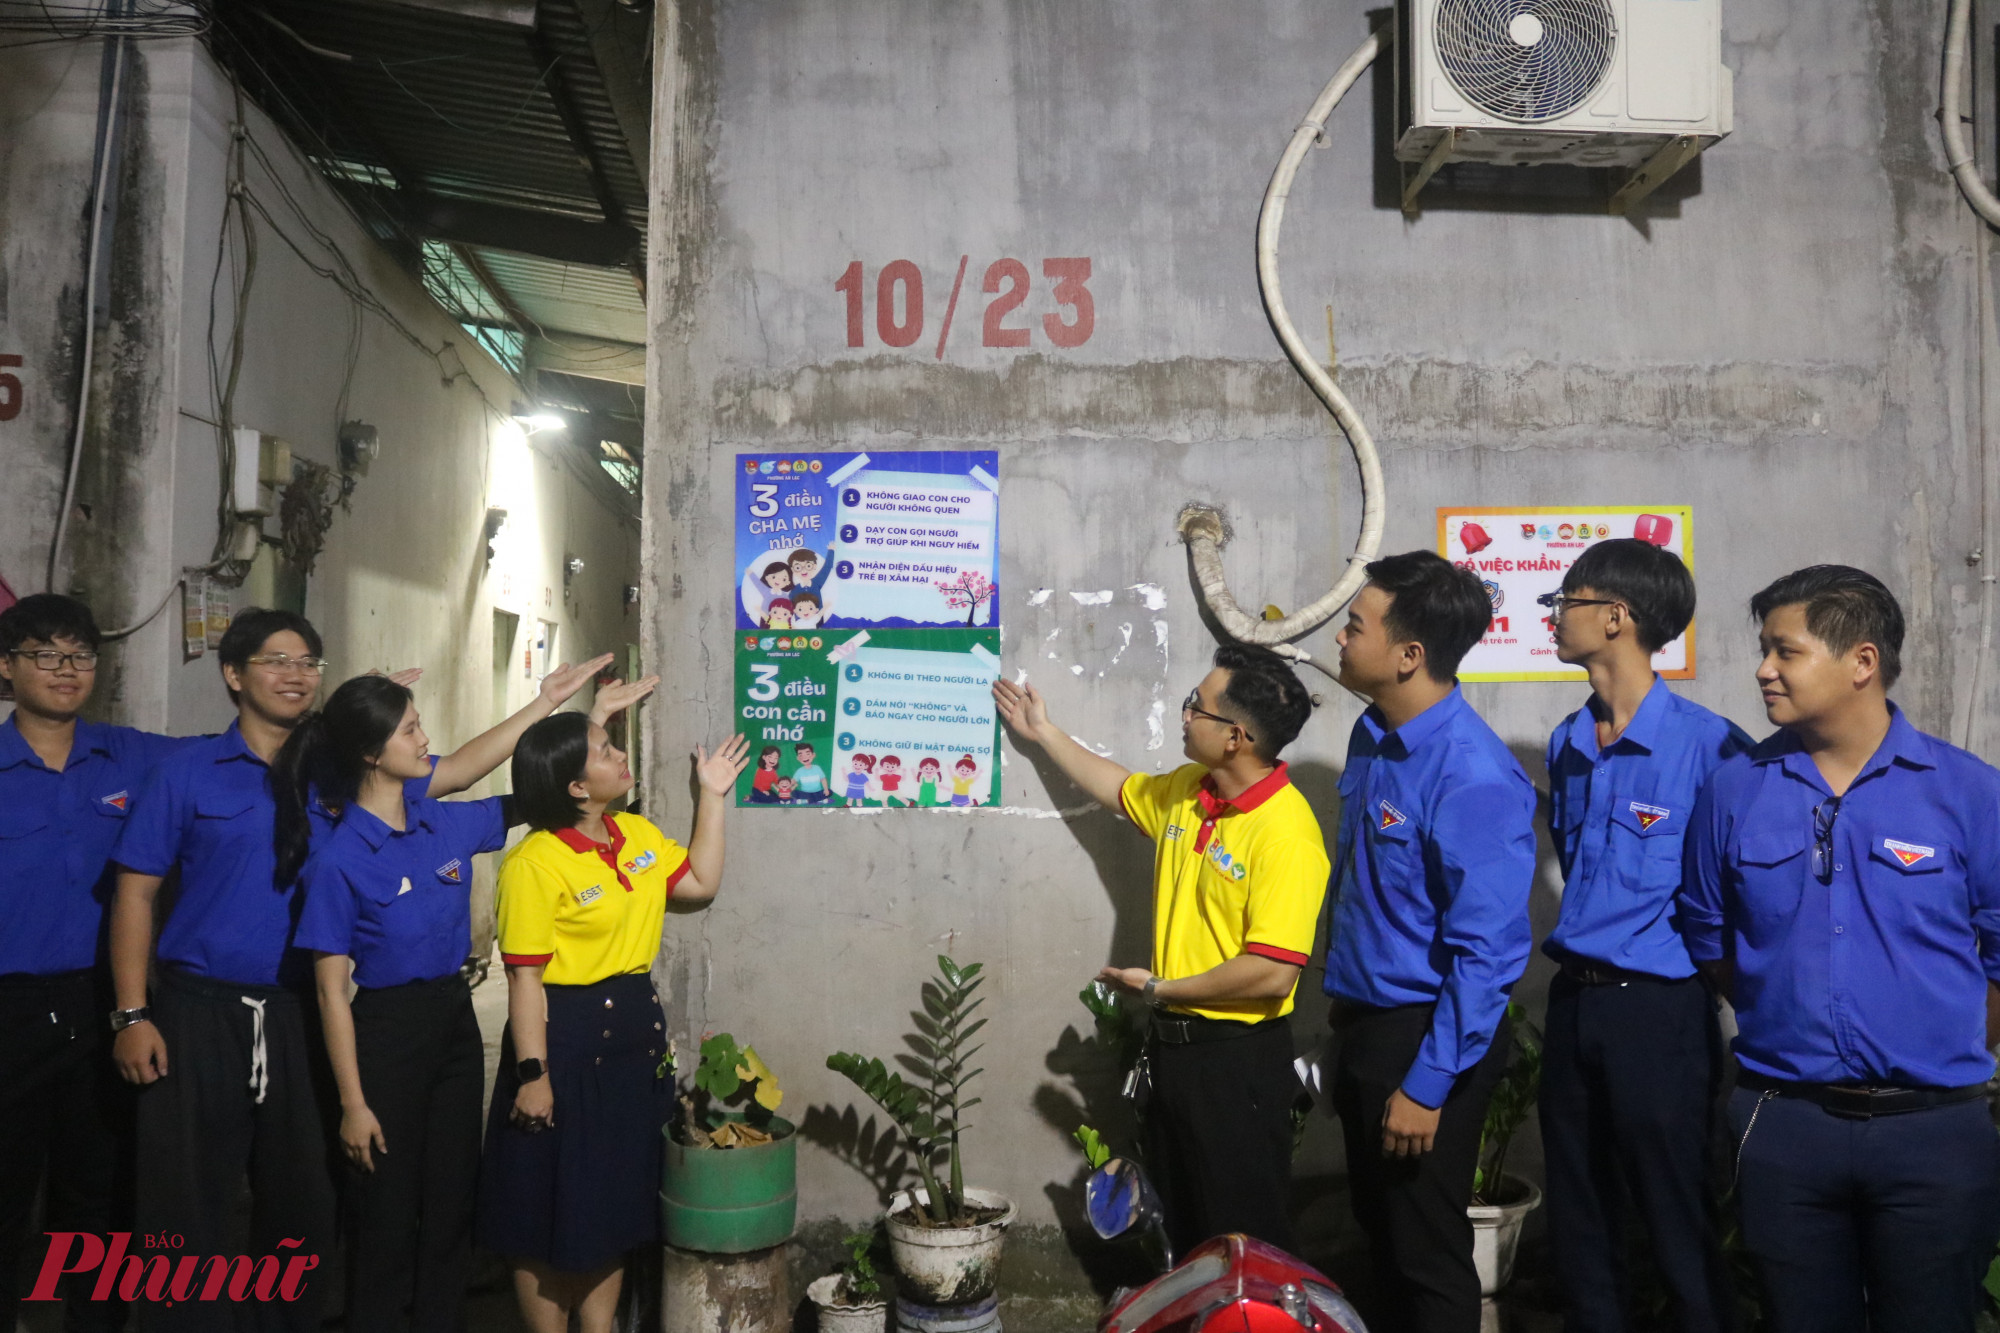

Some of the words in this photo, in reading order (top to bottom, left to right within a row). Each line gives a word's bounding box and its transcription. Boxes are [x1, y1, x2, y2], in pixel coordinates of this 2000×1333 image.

[835, 255, 1094, 361] 10/23
[750, 484, 779, 518] 3
[784, 489, 822, 507] điều
[867, 492, 900, 500] KHÔNG
[866, 502, 895, 511] NGƯỜI
[898, 504, 932, 513] KHÔNG
[749, 518, 788, 534] CHA
[793, 515, 821, 531] MẸ
[866, 526, 885, 535] DẠY
[910, 529, 926, 538] GỌI
[929, 529, 958, 537] NGƯỜI
[769, 533, 804, 550] nhớ
[865, 537, 883, 546] TRỢ
[887, 537, 908, 546] GIÚP
[842, 566, 848, 574] 3
[859, 561, 885, 570] NHẬN
[889, 562, 910, 572] DIỆN
[912, 563, 933, 572] DẤU
[936, 565, 957, 574] HIỆU
[1479, 558, 1513, 574] VIỆC
[878, 574, 887, 582] BỊ
[912, 576, 928, 584] HẠI
[748, 664, 780, 701] 3
[784, 676, 826, 696] điều
[868, 671, 900, 680] KHÔNG
[916, 674, 941, 682] THEO
[944, 675, 973, 684] NGƯỜI
[976, 678, 988, 686] LẠ
[742, 706, 781, 719] con
[787, 700, 826, 722] cần
[866, 698, 887, 707] DÁM
[890, 700, 906, 708] NÓI
[954, 703, 967, 712] VÀ
[865, 710, 885, 718] BÁO
[916, 714, 936, 722] CHO
[939, 715, 968, 724] NGƯỜI
[971, 716, 990, 724] LỚN
[763, 724, 804, 741] nhớ
[859, 739, 892, 748] KHÔNG
[895, 740, 912, 749] GIỮ
[914, 741, 922, 750] BÍ
[925, 742, 944, 752] MẬT
[948, 743, 975, 753] ĐÁNG
[978, 745, 990, 755] SỢ
[580, 885, 603, 901] ESET
